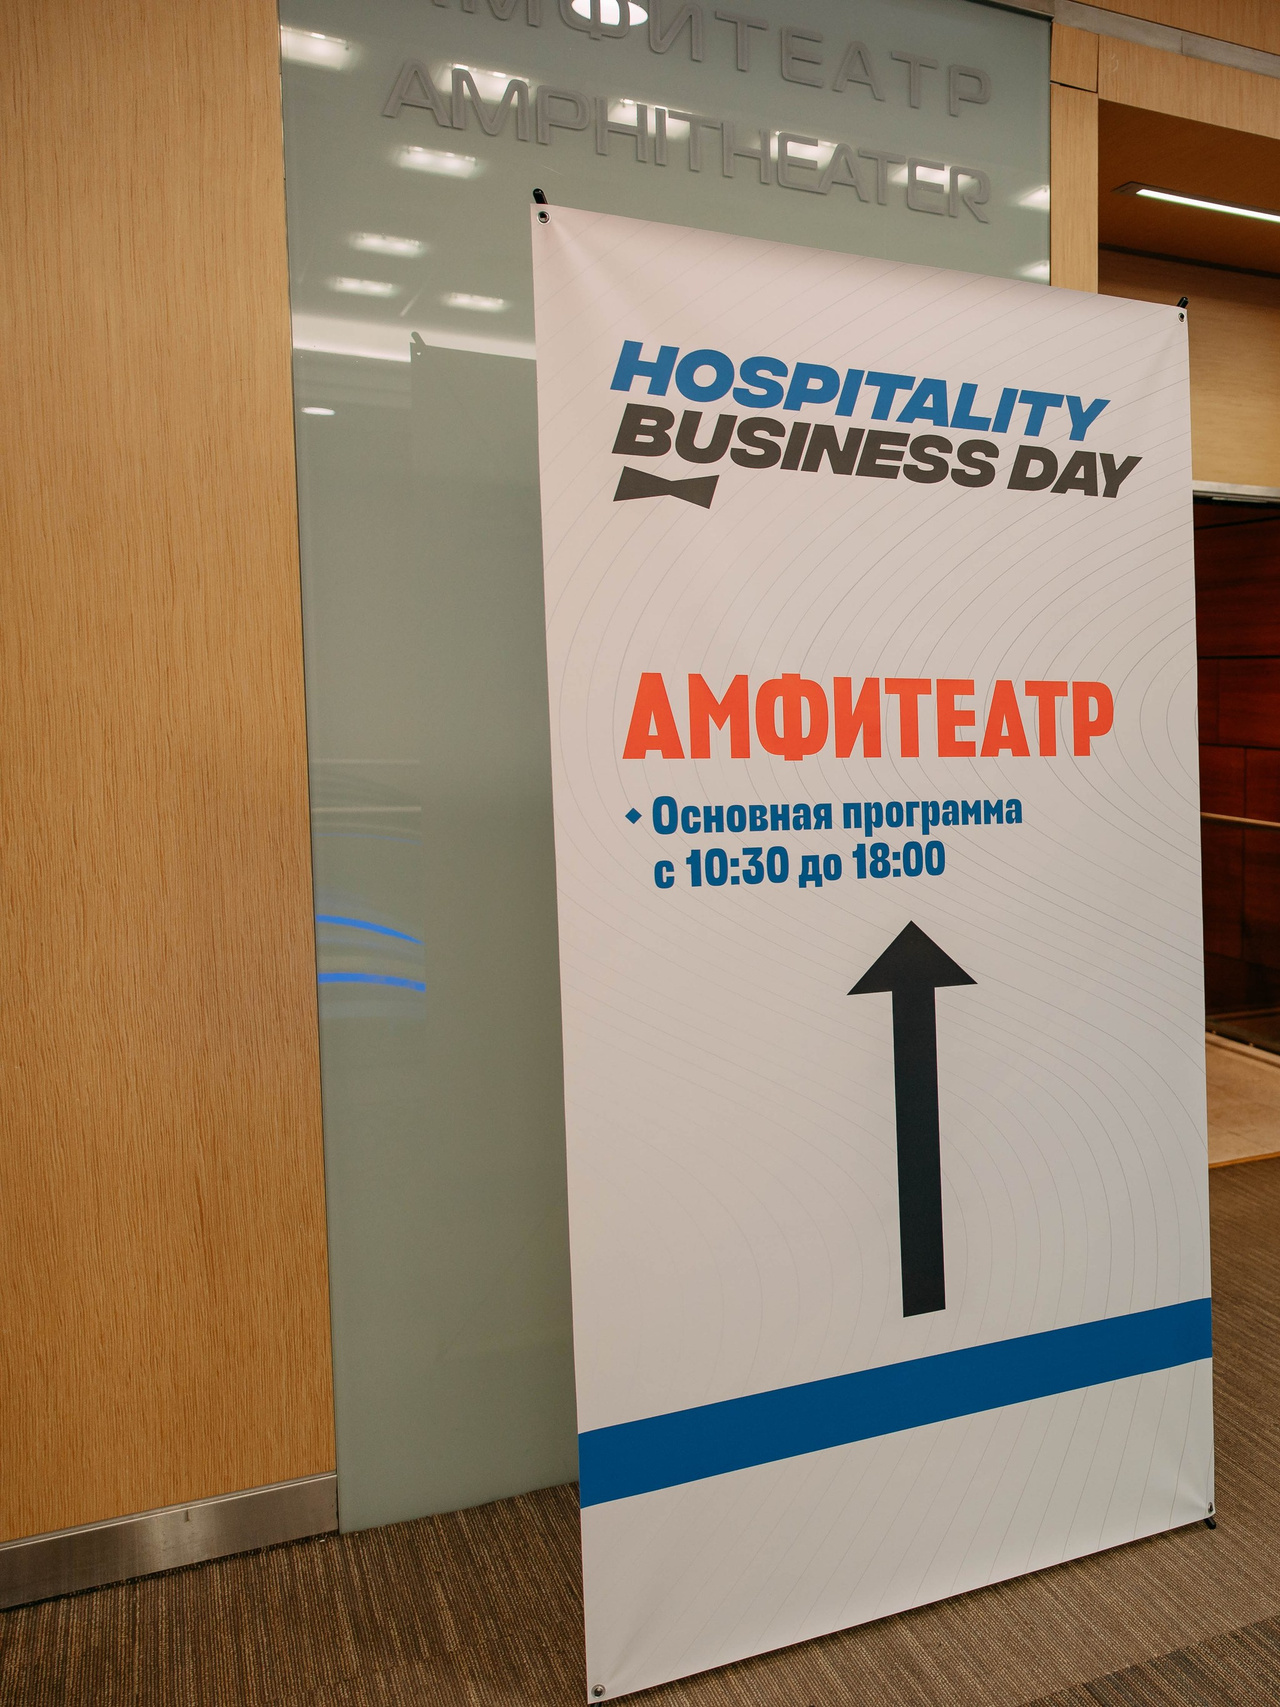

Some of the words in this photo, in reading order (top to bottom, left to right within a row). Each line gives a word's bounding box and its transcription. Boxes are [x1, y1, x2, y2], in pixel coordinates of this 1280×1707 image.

[382, 59, 990, 224] AMPHITHEATER
[610, 340, 1111, 441] HOSPITALITY
[611, 402, 999, 488] BUSINESS
[1007, 444, 1143, 498] DAY
[622, 672, 1114, 761] АМФИТЕАТР
[652, 796, 832, 835] Основная
[843, 797, 1023, 837] программа
[654, 859, 675, 889] с
[686, 846, 789, 887] 10:30
[798, 851, 842, 889] до
[853, 840, 946, 880] 18:00
